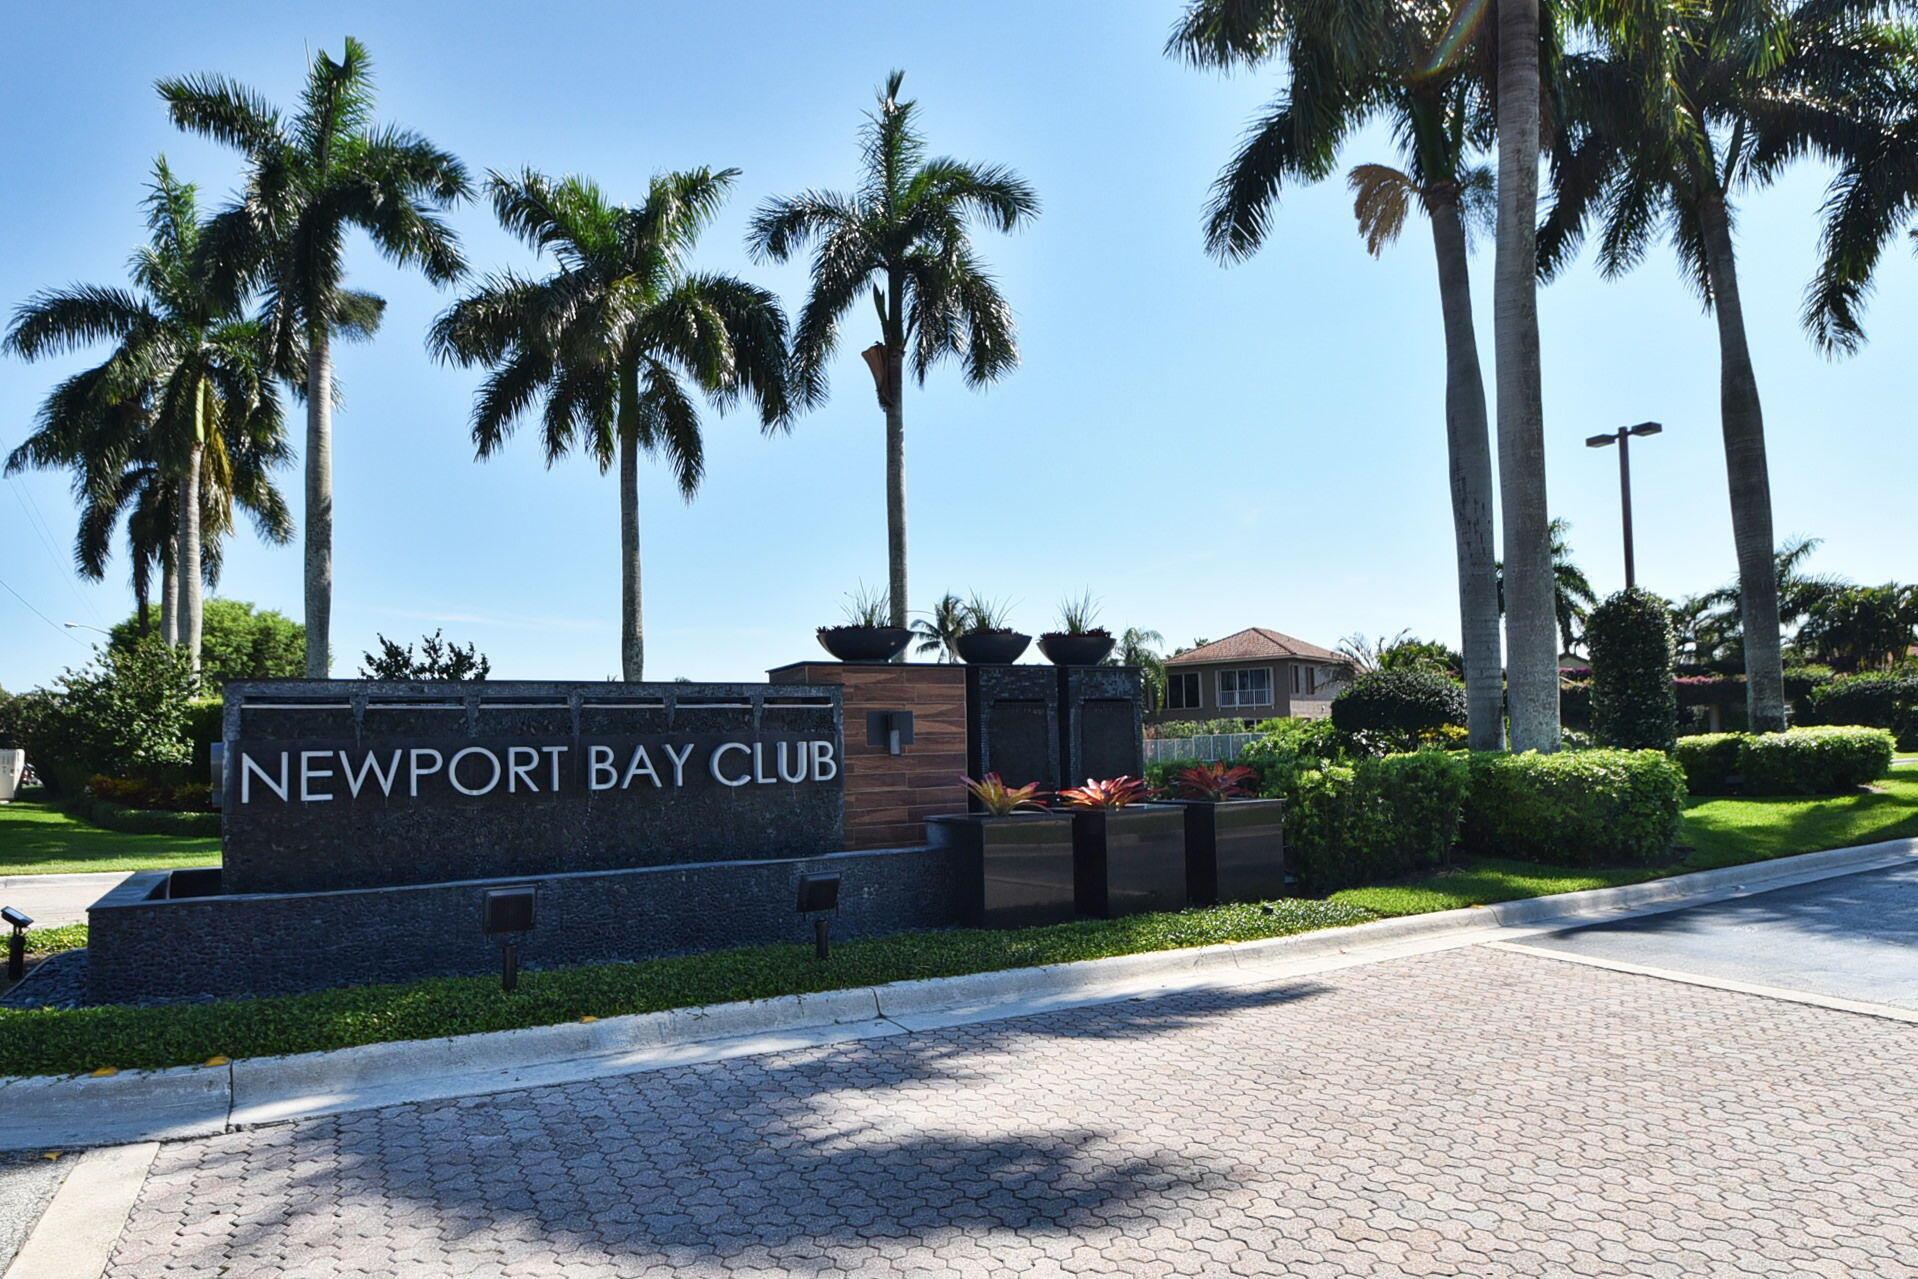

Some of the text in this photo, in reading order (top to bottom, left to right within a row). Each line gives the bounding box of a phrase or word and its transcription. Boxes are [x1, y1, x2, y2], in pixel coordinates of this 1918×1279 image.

[241, 740, 838, 804] NEWPORT BAY CLUB
